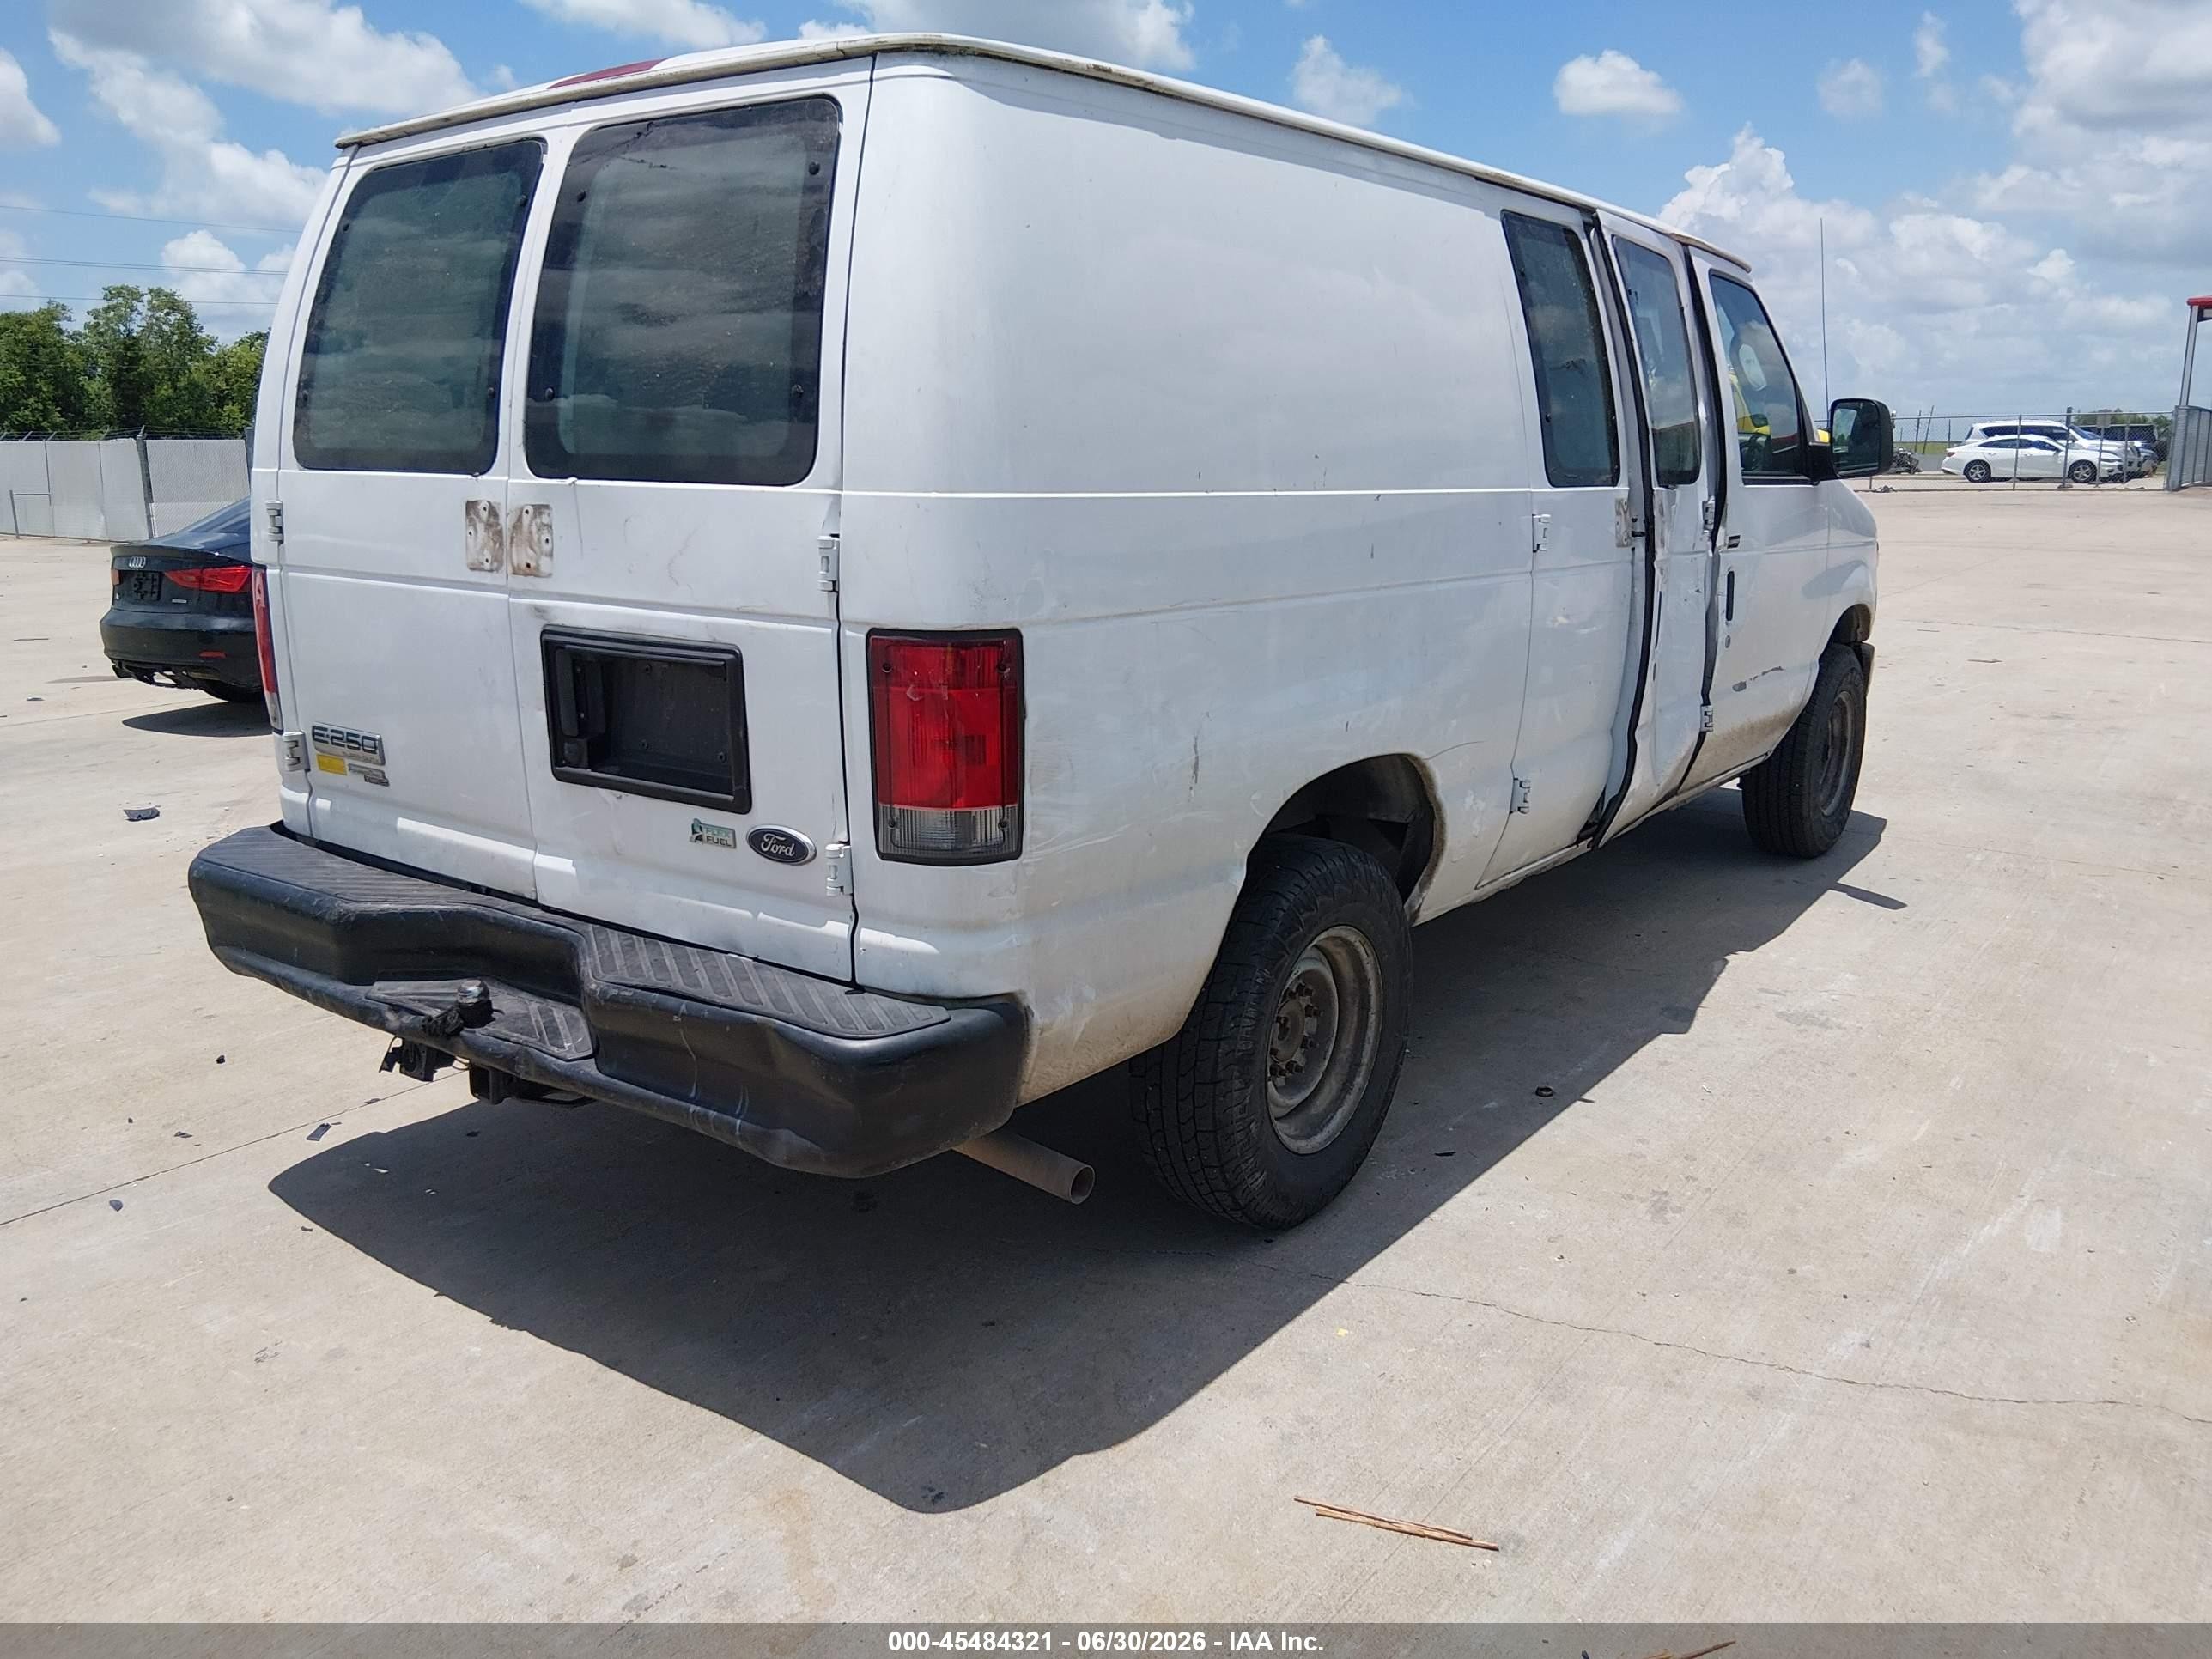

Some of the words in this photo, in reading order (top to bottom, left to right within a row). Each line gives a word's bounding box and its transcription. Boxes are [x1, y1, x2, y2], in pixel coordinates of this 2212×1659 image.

[312, 726, 379, 755] E-250
[706, 836, 732, 847] FUEL
[761, 833, 796, 857] Ford
